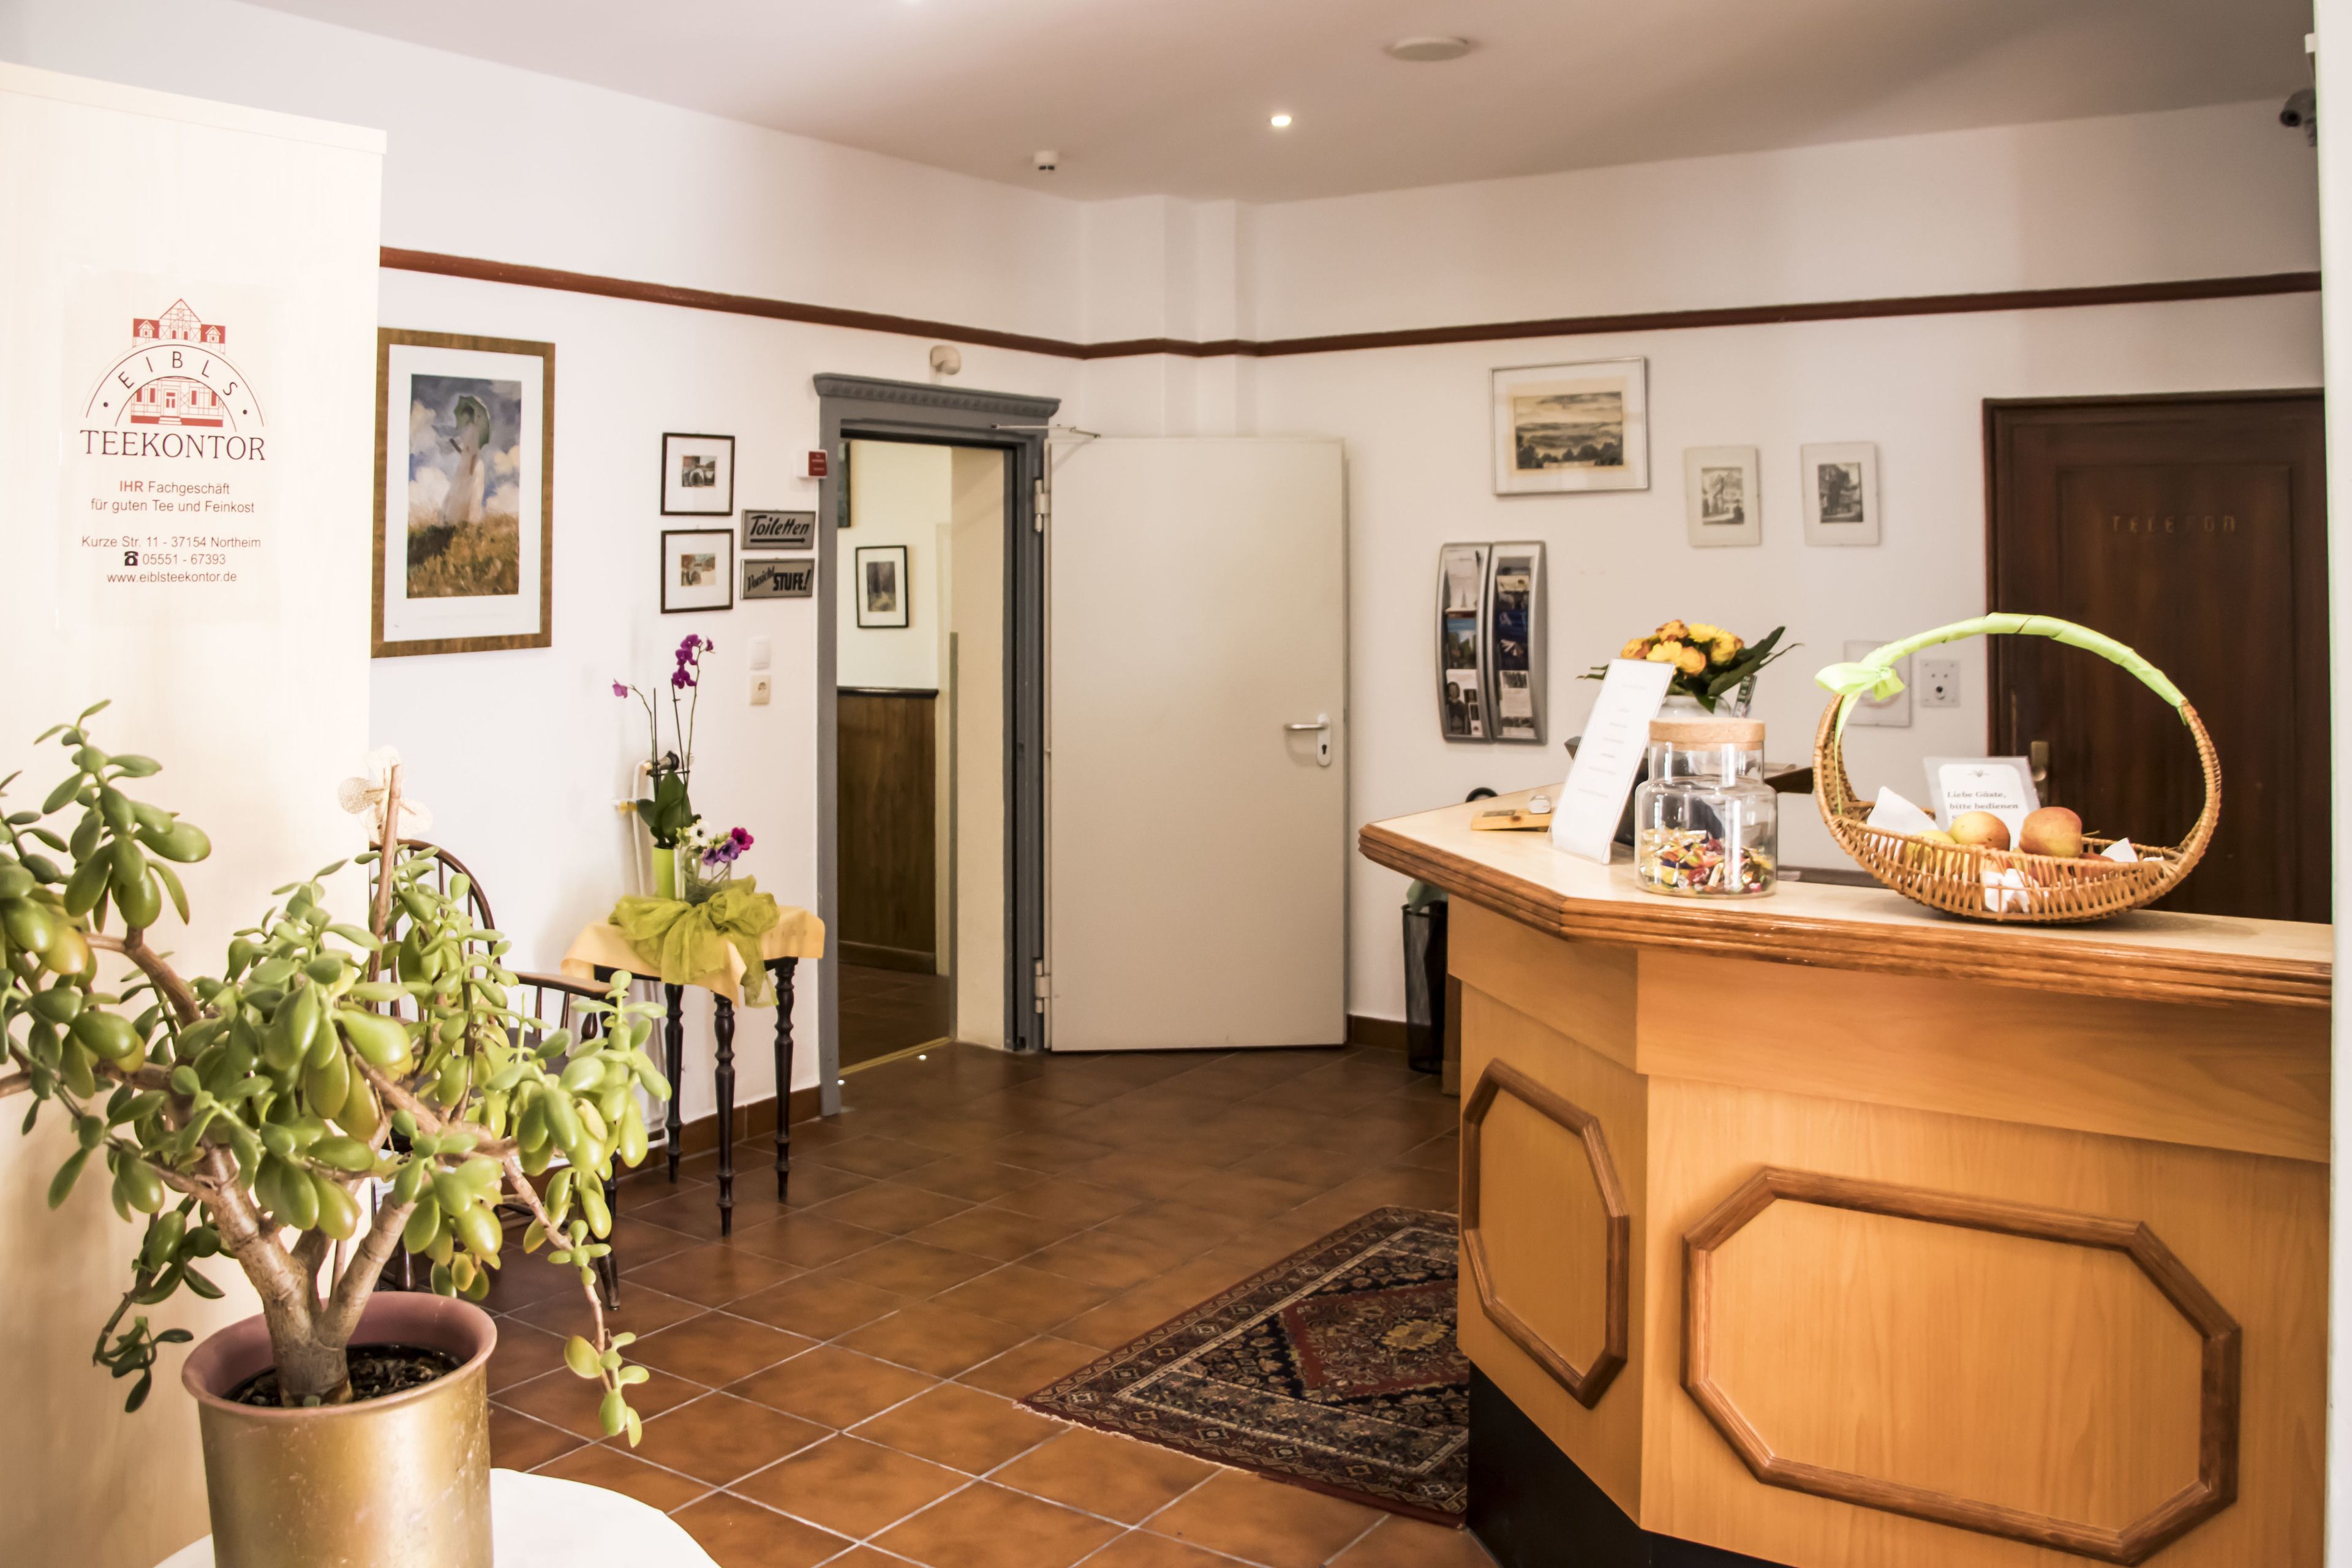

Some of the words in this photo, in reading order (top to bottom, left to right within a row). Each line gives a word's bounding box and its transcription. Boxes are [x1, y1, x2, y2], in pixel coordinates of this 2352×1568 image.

[118, 351, 238, 396] EIBLS
[80, 429, 266, 461] TEEKONTOR
[119, 480, 144, 492] IHR
[148, 480, 230, 496] Fachgeschäft
[90, 497, 108, 511] für
[111, 499, 148, 514] guten
[151, 499, 174, 512] Tee
[178, 500, 201, 513] und
[204, 500, 255, 513] Feinkost
[750, 514, 810, 536] Toiletten
[81, 535, 118, 548] Kurze
[122, 535, 141, 548] Str.
[146, 536, 157, 548] 11
[171, 536, 206, 548] 37154
[211, 536, 261, 548] Northeim
[142, 553, 178, 565] 05551
[190, 553, 226, 565] 67393
[107, 570, 237, 583] www.eiblsteekontor.de
[773, 569, 811, 591] STUFE!
